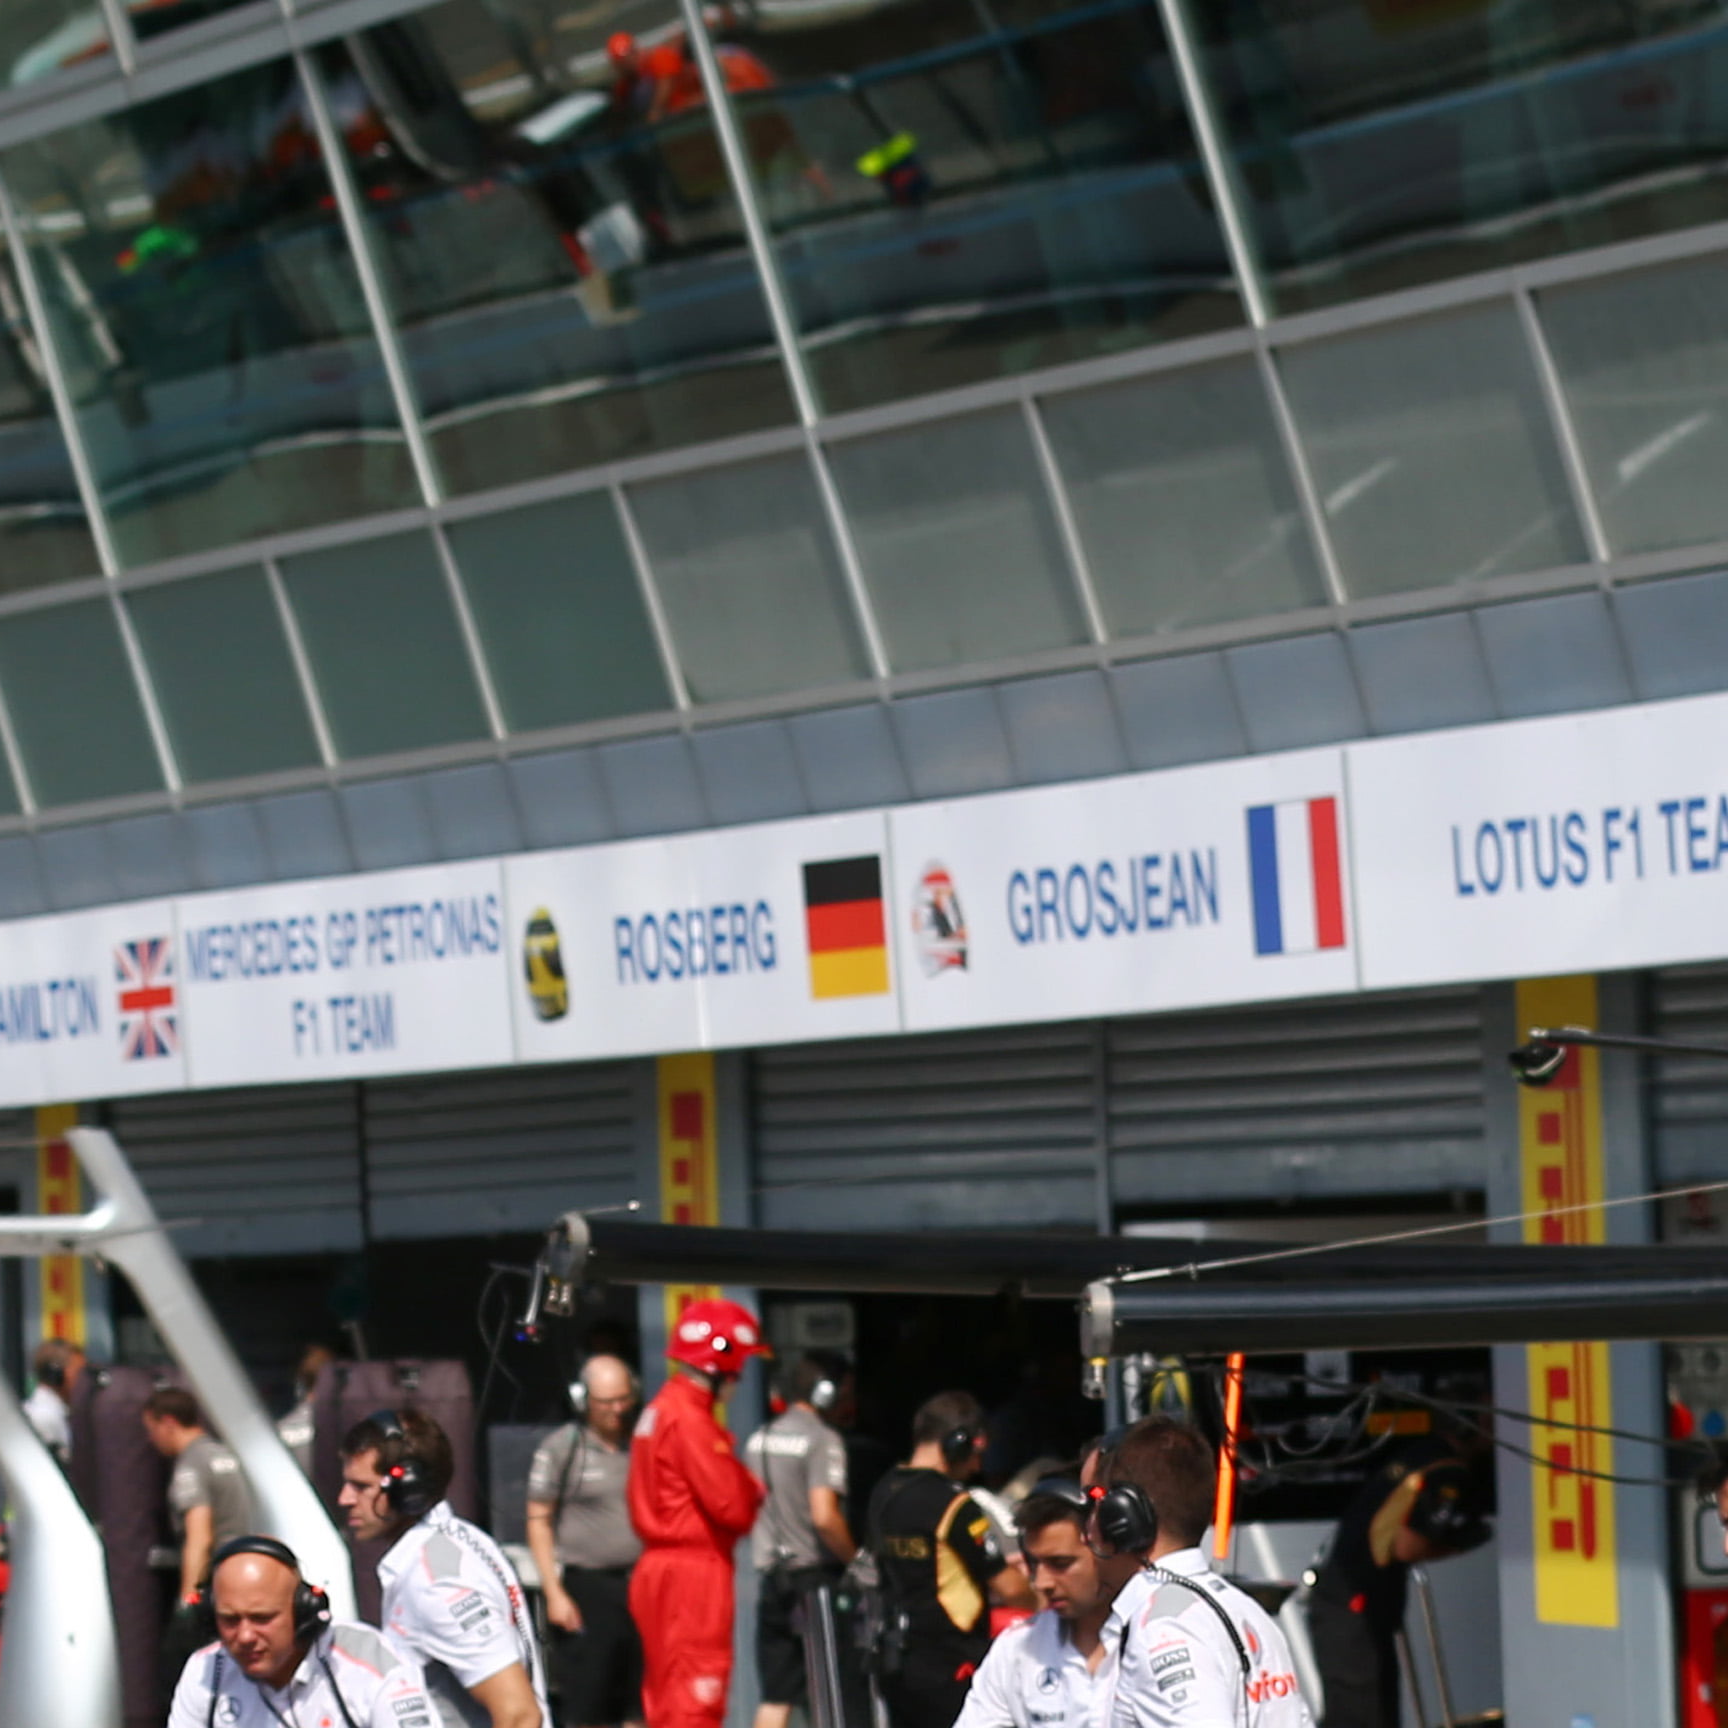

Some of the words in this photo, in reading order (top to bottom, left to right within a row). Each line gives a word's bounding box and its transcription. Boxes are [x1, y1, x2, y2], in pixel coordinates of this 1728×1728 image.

[1007, 848, 1220, 944] GROSJEAN
[1453, 812, 1587, 898] LOTUS
[1602, 808, 1644, 882] F1
[186, 908, 318, 981] MERCEDES
[325, 908, 358, 970] GP
[367, 894, 501, 964] PETRONAS
[614, 900, 778, 986] ROSBERG
[292, 1000, 319, 1056] F1
[328, 994, 396, 1053] TEAM
